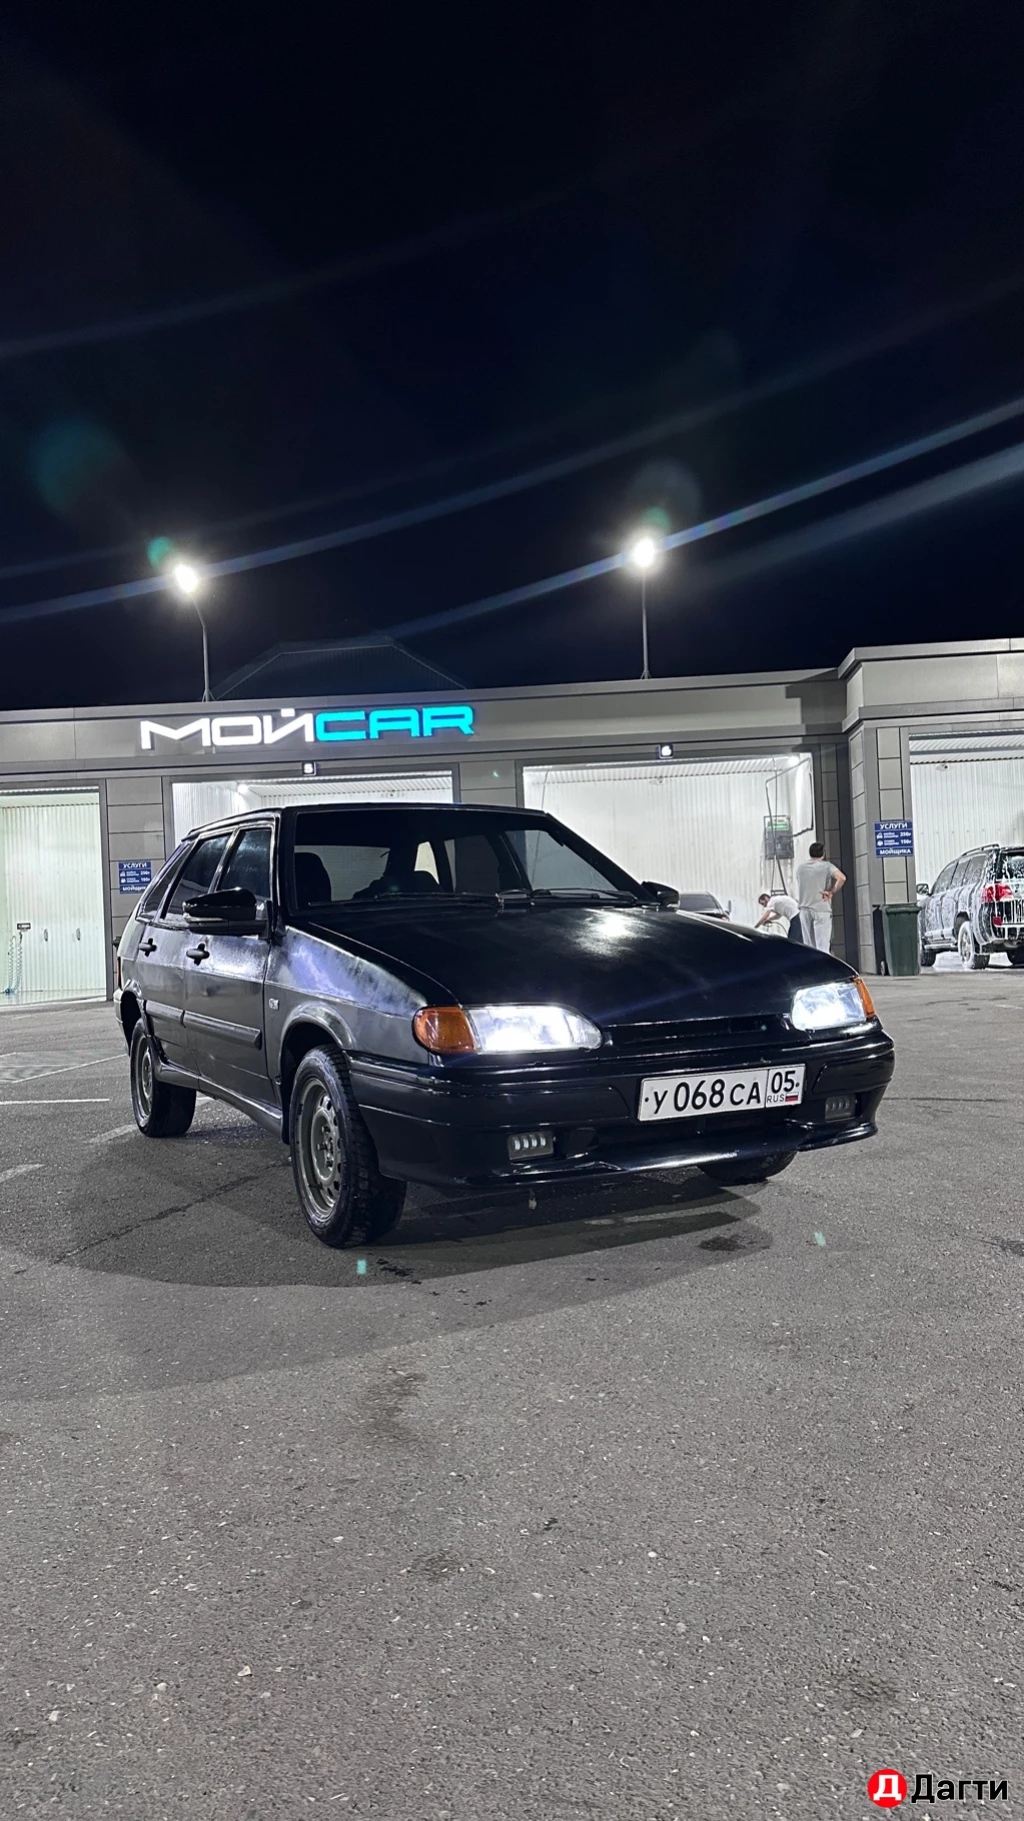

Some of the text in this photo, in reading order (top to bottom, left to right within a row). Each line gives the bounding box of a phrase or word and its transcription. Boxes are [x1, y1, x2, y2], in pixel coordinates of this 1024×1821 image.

[879, 847, 912, 855] МОЙЩИКА
[770, 1070, 796, 1094] 05
[766, 1093, 785, 1104] RUS
